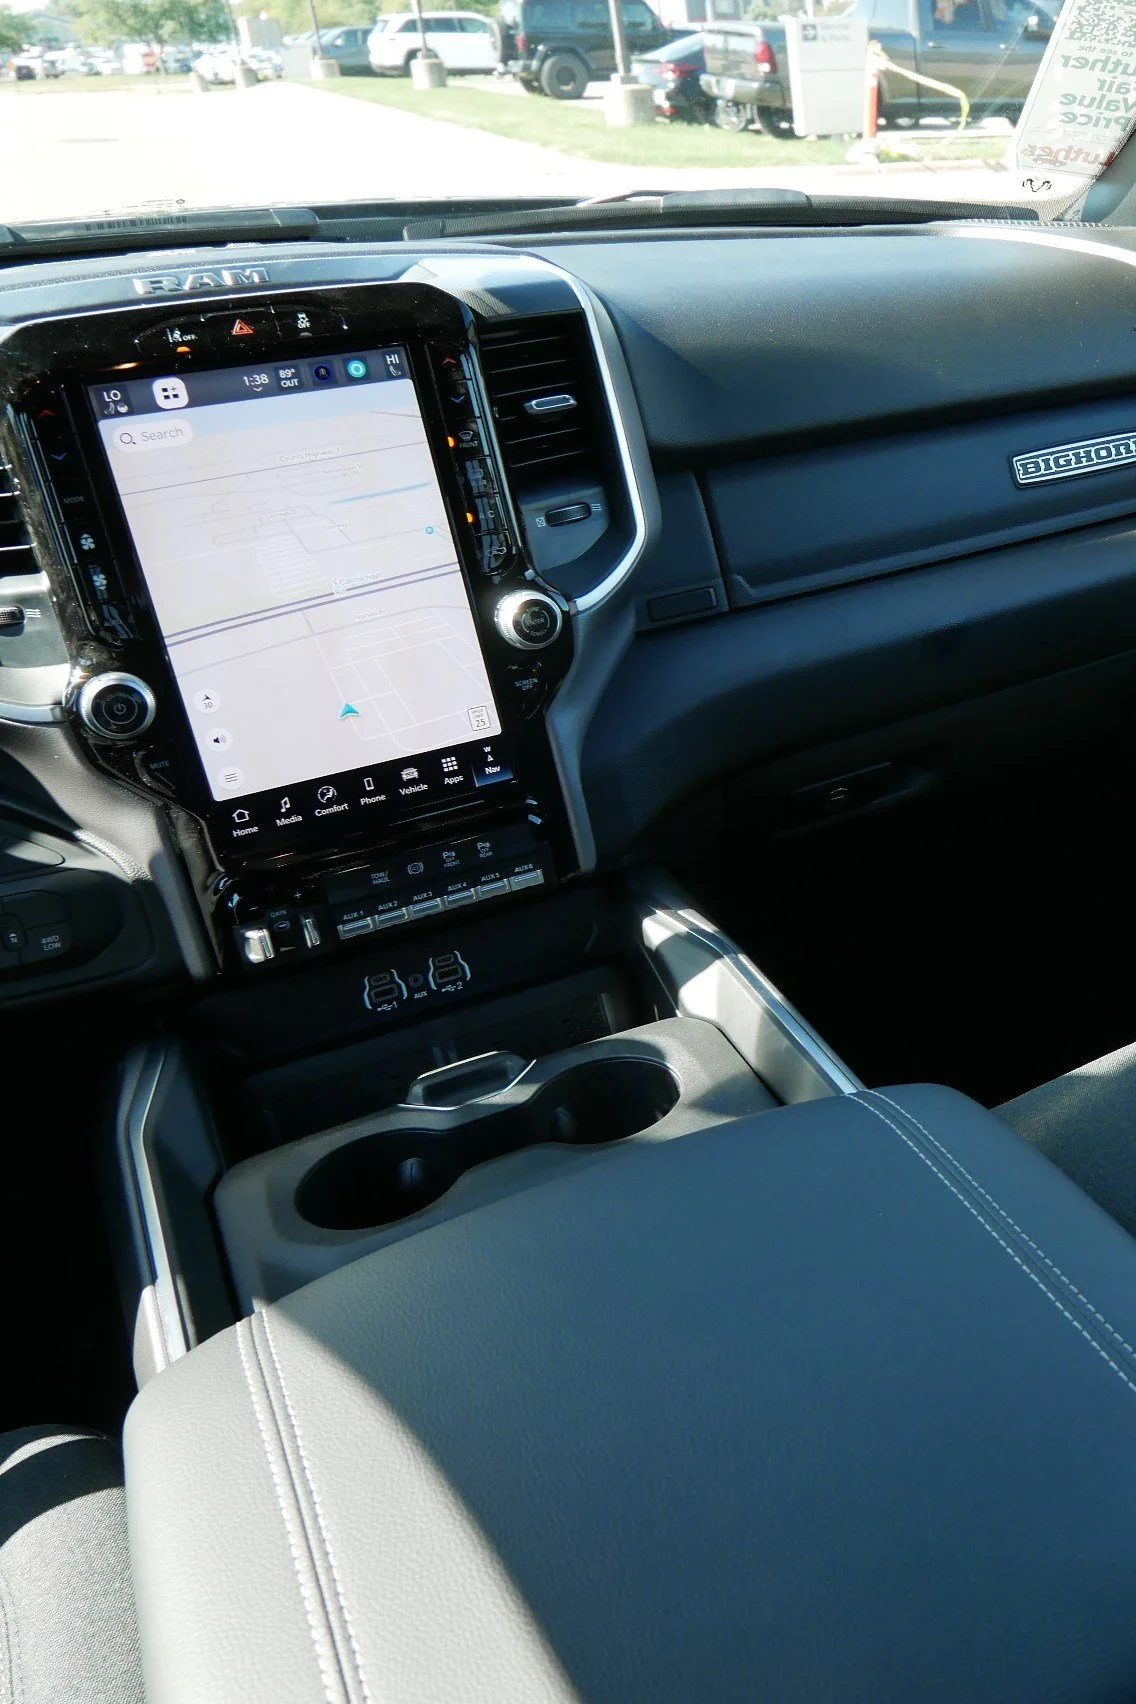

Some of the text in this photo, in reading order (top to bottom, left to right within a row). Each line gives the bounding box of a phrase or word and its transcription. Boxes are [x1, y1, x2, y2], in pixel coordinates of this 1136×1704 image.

[133, 267, 270, 294] RAM
[386, 354, 399, 365] HI
[279, 368, 296, 379] 89°
[243, 374, 269, 386] 1:38
[281, 378, 299, 388] OUT
[103, 390, 121, 402] LO
[141, 427, 184, 442] Search
[460, 440, 479, 448] FRONT
[334, 588, 345, 596] Rd
[475, 718, 486, 728] 25
[233, 765, 501, 838] Home Media Comfort Phone Vehicle Apps Nav
[514, 865, 528, 873] AUX
[481, 874, 495, 882] AUX
[447, 883, 462, 892] AUX
[413, 892, 428, 901] AUX
[378, 902, 393, 911] AUX
[343, 912, 358, 921] AUX
[41, 935, 60, 944] 4WD
[44, 942, 61, 951] LOW
[457, 981, 463, 989] 2
[414, 990, 428, 999] AUX
